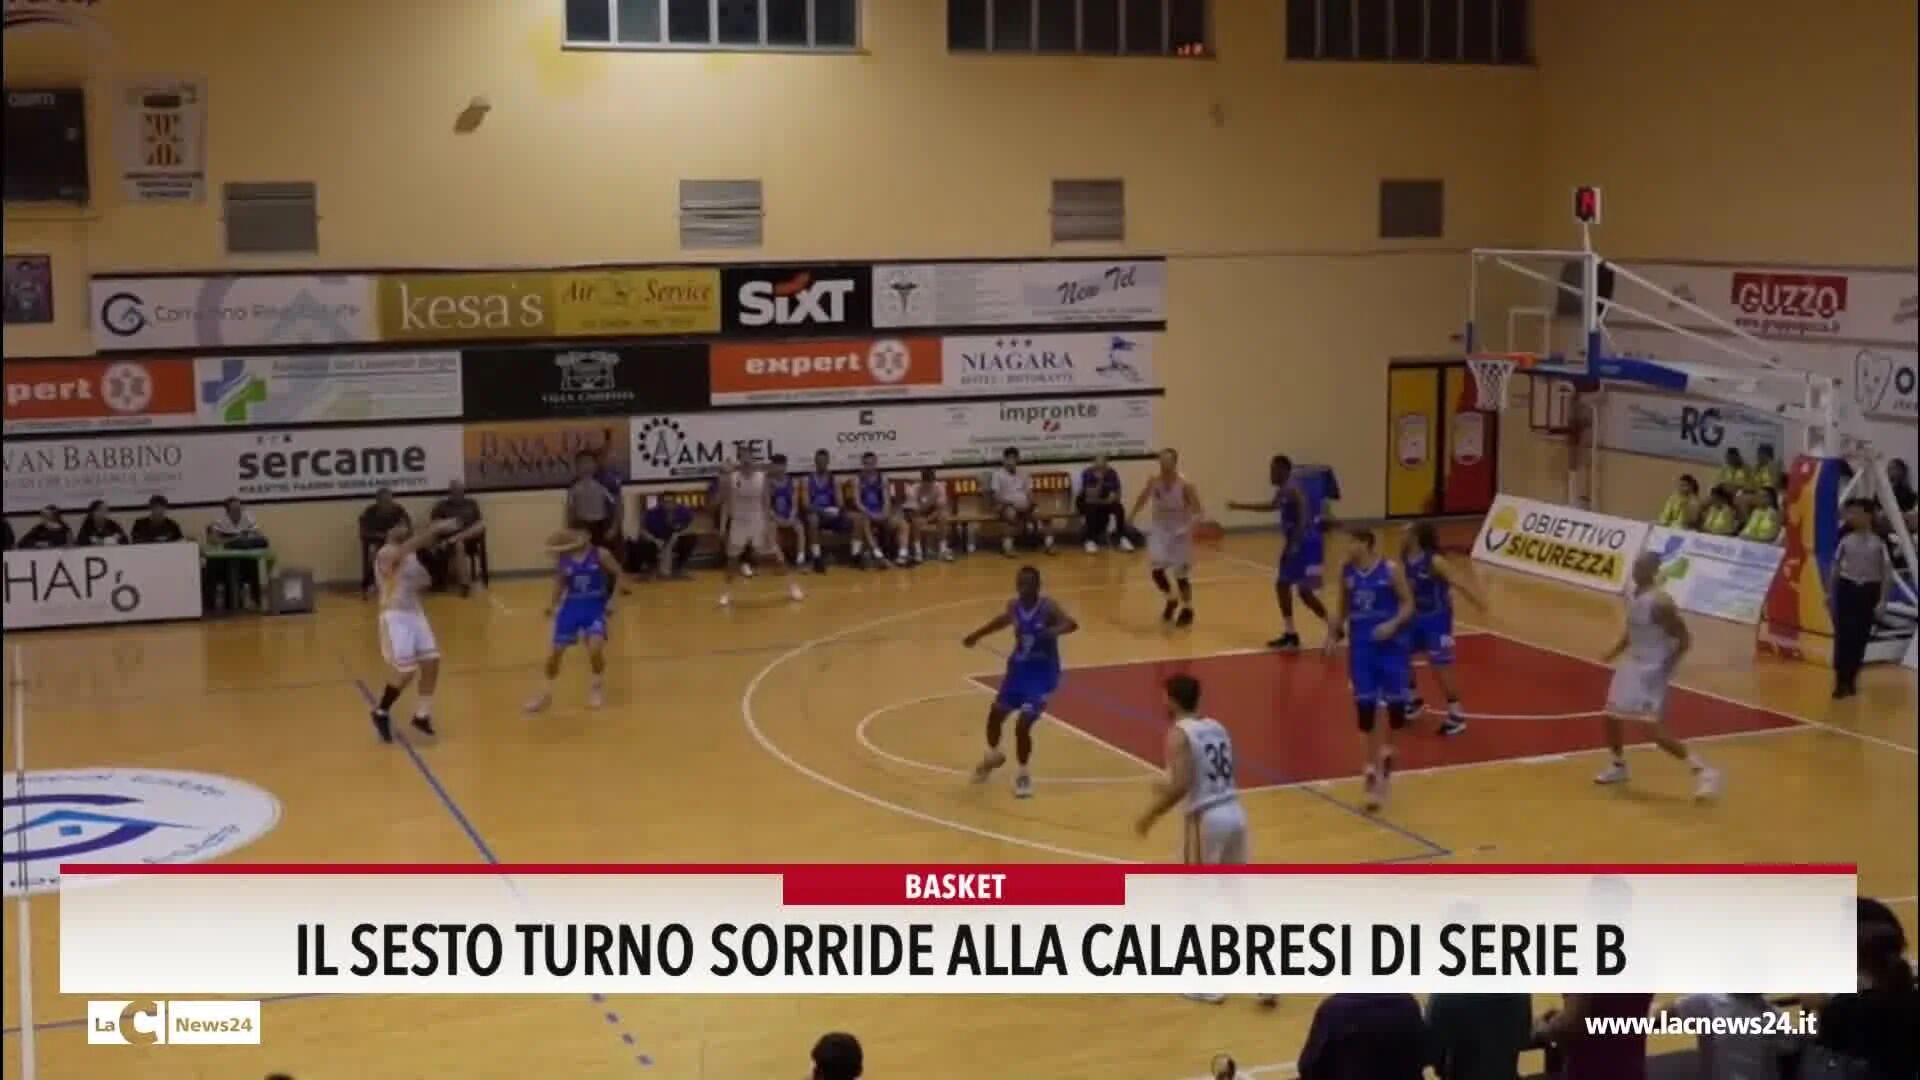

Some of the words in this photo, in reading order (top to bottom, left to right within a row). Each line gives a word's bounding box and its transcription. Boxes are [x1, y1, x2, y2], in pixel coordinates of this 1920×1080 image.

[400, 282, 544, 330] kesa's
[644, 279, 711, 304] Service
[1739, 282, 1839, 318] GUZZO
[744, 353, 861, 378] expert
[960, 352, 1075, 371] NIAGARA
[1000, 402, 1098, 425] impronte
[1680, 407, 1724, 447] RG
[836, 428, 897, 443] comma
[63, 444, 183, 471] BABBINO
[239, 443, 426, 480] sercame
[1521, 512, 1626, 551] OBIETTIVO
[1505, 538, 1616, 577] SICUREZZA
[1204, 741, 1234, 782] 36
